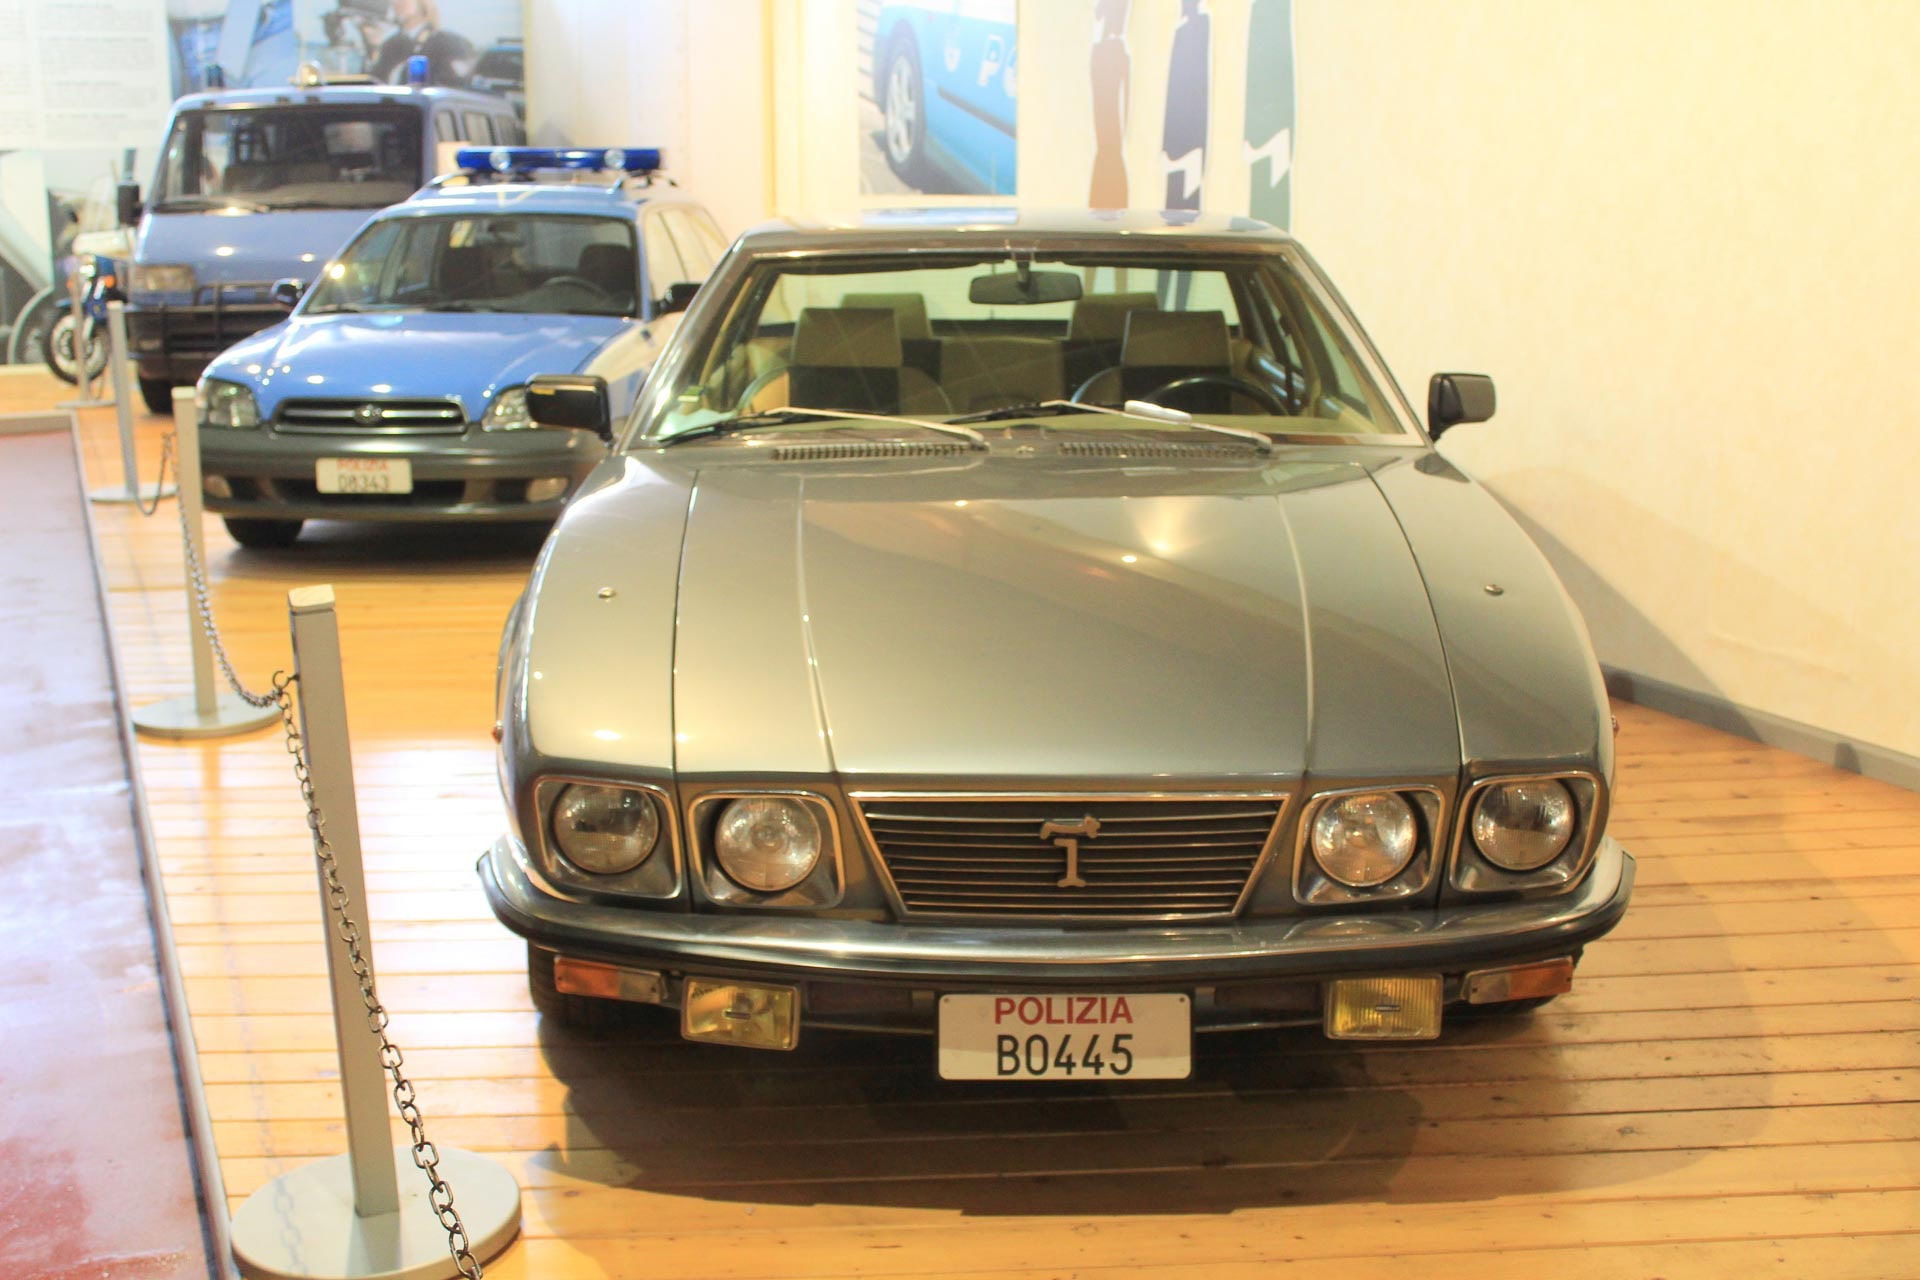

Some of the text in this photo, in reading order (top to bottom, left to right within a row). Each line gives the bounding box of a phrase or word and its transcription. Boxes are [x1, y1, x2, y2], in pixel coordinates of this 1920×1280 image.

[337, 458, 388, 471] POLIZIA
[994, 996, 1134, 1025] POLIZIA
[996, 1034, 1134, 1076] B0445
